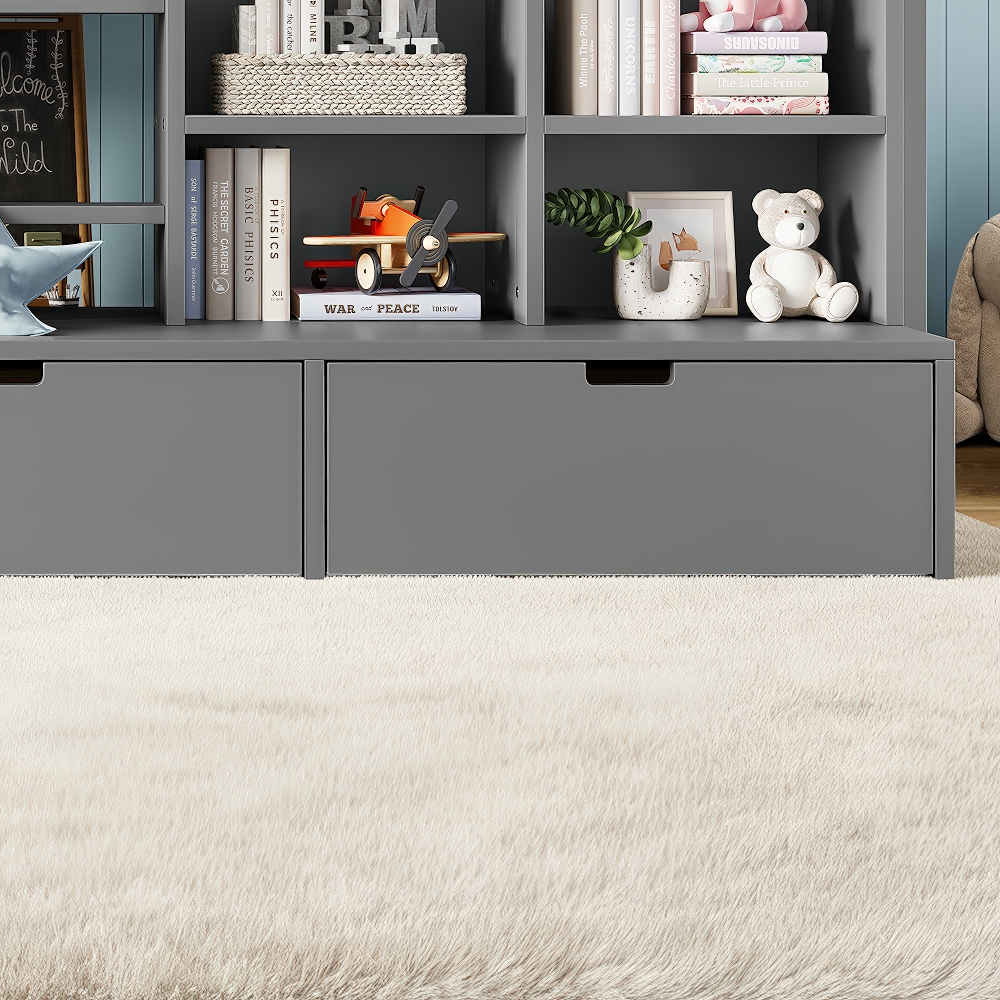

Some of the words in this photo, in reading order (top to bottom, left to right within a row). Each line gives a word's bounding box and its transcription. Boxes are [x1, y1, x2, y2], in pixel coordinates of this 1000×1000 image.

[579, 13, 588, 36] Pooh
[664, 1, 676, 28] Web
[309, 13, 317, 43] MILNE
[579, 38, 588, 56] The
[724, 36, 800, 50] DINOSAURS
[716, 77, 738, 89] The
[739, 77, 769, 89] Little
[771, 77, 809, 89] Prince
[8, 108, 38, 132] The
[220, 180, 229, 198] THE
[220, 199, 229, 234] SECRET
[244, 186, 254, 224] BASIC
[270, 199, 279, 260] PHISICS
[220, 238, 229, 276] GARDEN
[244, 231, 254, 283] PHISICS
[324, 304, 356, 314] WAR
[377, 304, 420, 314] PEACE
